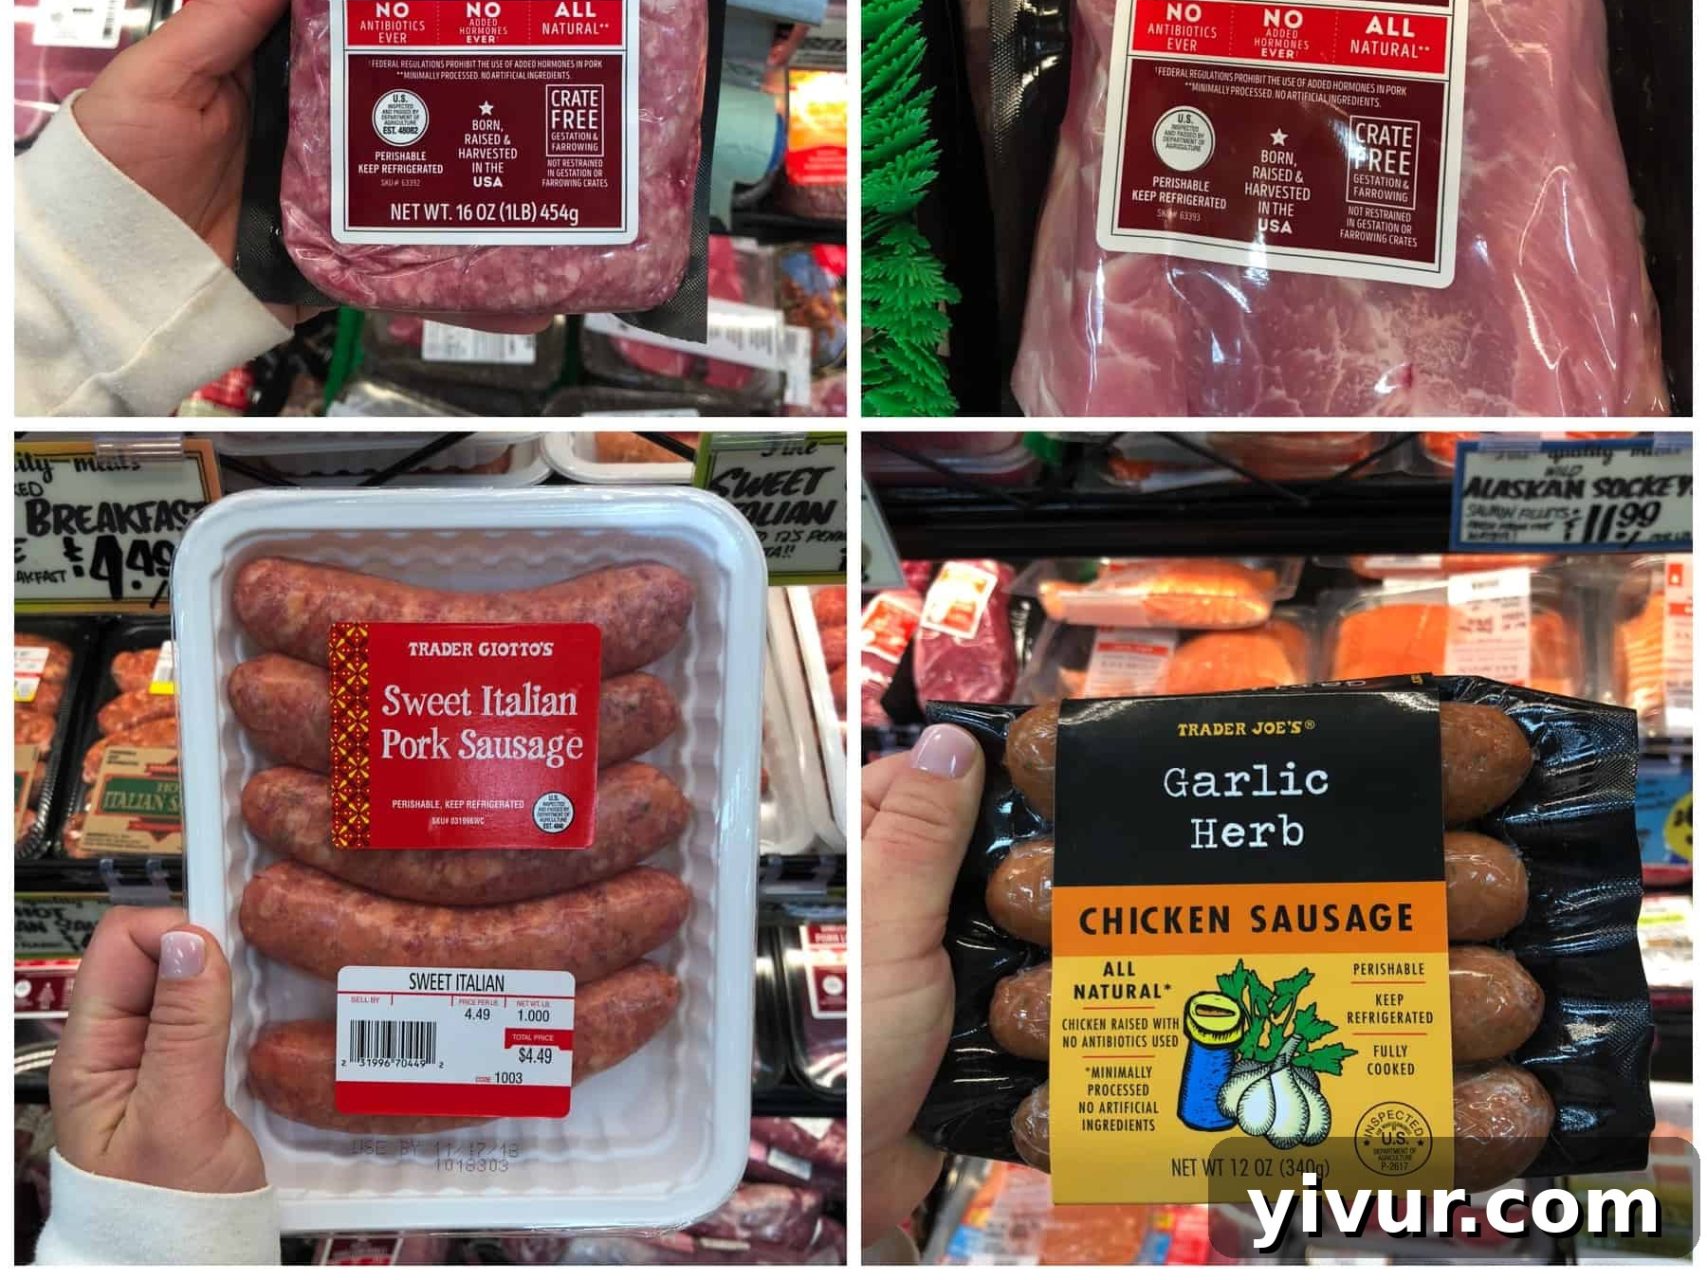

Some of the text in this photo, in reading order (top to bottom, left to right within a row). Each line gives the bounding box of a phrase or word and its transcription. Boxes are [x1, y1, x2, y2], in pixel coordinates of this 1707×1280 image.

[376, 2, 409, 18] NO
[555, 2, 597, 18] ALL
[360, 20, 426, 32] ANTIBIOTICS
[1148, 23, 1218, 39] ANTIBIOTICS
[379, 32, 407, 44] EVER
[1254, 37, 1310, 50] HORMONES
[551, 90, 599, 108] CRATE
[472, 119, 504, 134] BORN,
[551, 110, 599, 130] FREE
[464, 134, 502, 146] RAISED
[551, 142, 599, 153] FARROWING
[375, 151, 426, 162] PERISHABLE
[458, 147, 518, 160] HARVESTED
[382, 163, 443, 175] REFRIGERATED
[473, 176, 503, 188] USA
[391, 202, 579, 226] NET WT. 16 OZ (1LB) 454g
[1365, 209, 1411, 222] RESTRAINED
[710, 466, 835, 498] SWEET
[1463, 476, 1584, 500] ALASKAN
[408, 641, 554, 656] TRADER GIOTTO'S
[382, 682, 577, 717] Sweet Italian
[1178, 721, 1247, 737] TRADER
[381, 727, 583, 768] Pork Sausage
[1163, 761, 1329, 799] Garlic
[445, 800, 464, 809] KEEP
[466, 800, 525, 809] REFRIGERATED
[1191, 813, 1305, 849] Herb
[1079, 902, 1415, 935] CHICKEN SAUSAGE
[1102, 961, 1136, 977] ALL
[1353, 962, 1425, 977] PERISHABLE
[409, 973, 505, 992] SWEET ITALIAN
[1375, 993, 1405, 1008] KEEP
[465, 1008, 490, 1021] 4.49
[518, 1009, 550, 1022] 1.000
[1346, 1010, 1434, 1025] REFRIGERATED
[1062, 1015, 1180, 1032] CHICKEN RAISED WITH
[1081, 1033, 1179, 1049] ANTIBIOTICS USED
[519, 1048, 552, 1064] $4.49
[1373, 1044, 1408, 1059] FULLY
[1367, 1062, 1416, 1077] COOKED
[495, 1072, 523, 1083] 1003
[1087, 1082, 1150, 1097] PROCESSED
[1099, 1099, 1159, 1115] ARTIFICIAL
[1081, 1117, 1156, 1133] INGREDIENTS
[1171, 1158, 1275, 1178] NET WT 12 OZ
